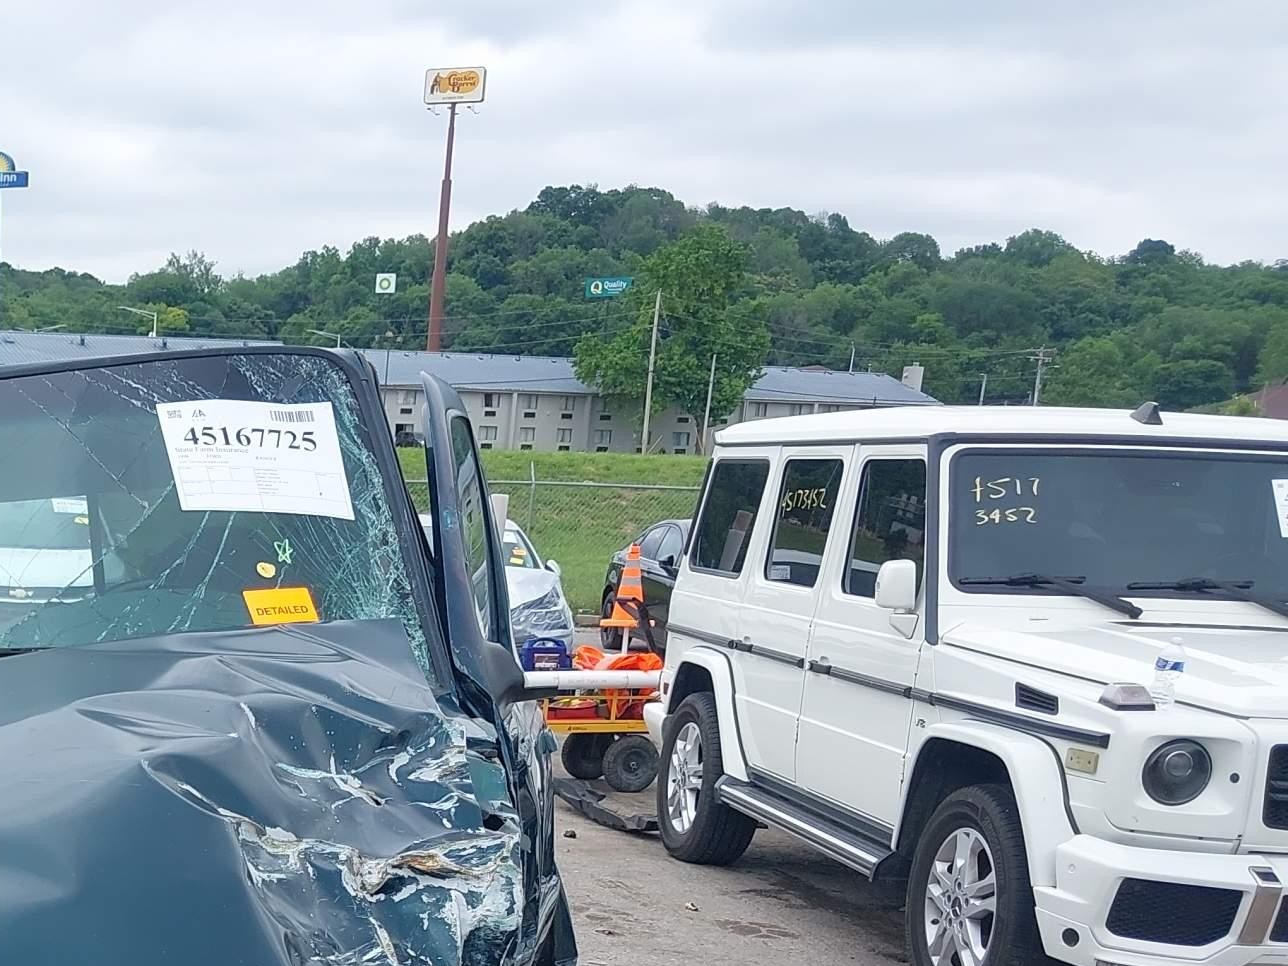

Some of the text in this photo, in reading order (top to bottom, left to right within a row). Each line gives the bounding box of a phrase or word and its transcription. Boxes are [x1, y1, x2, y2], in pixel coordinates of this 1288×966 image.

[0, 172, 17, 183] Inn
[604, 280, 627, 290] Quality
[184, 426, 317, 452] 45167725
[975, 507, 1038, 525] 3452
[255, 605, 309, 616] DETAILED
